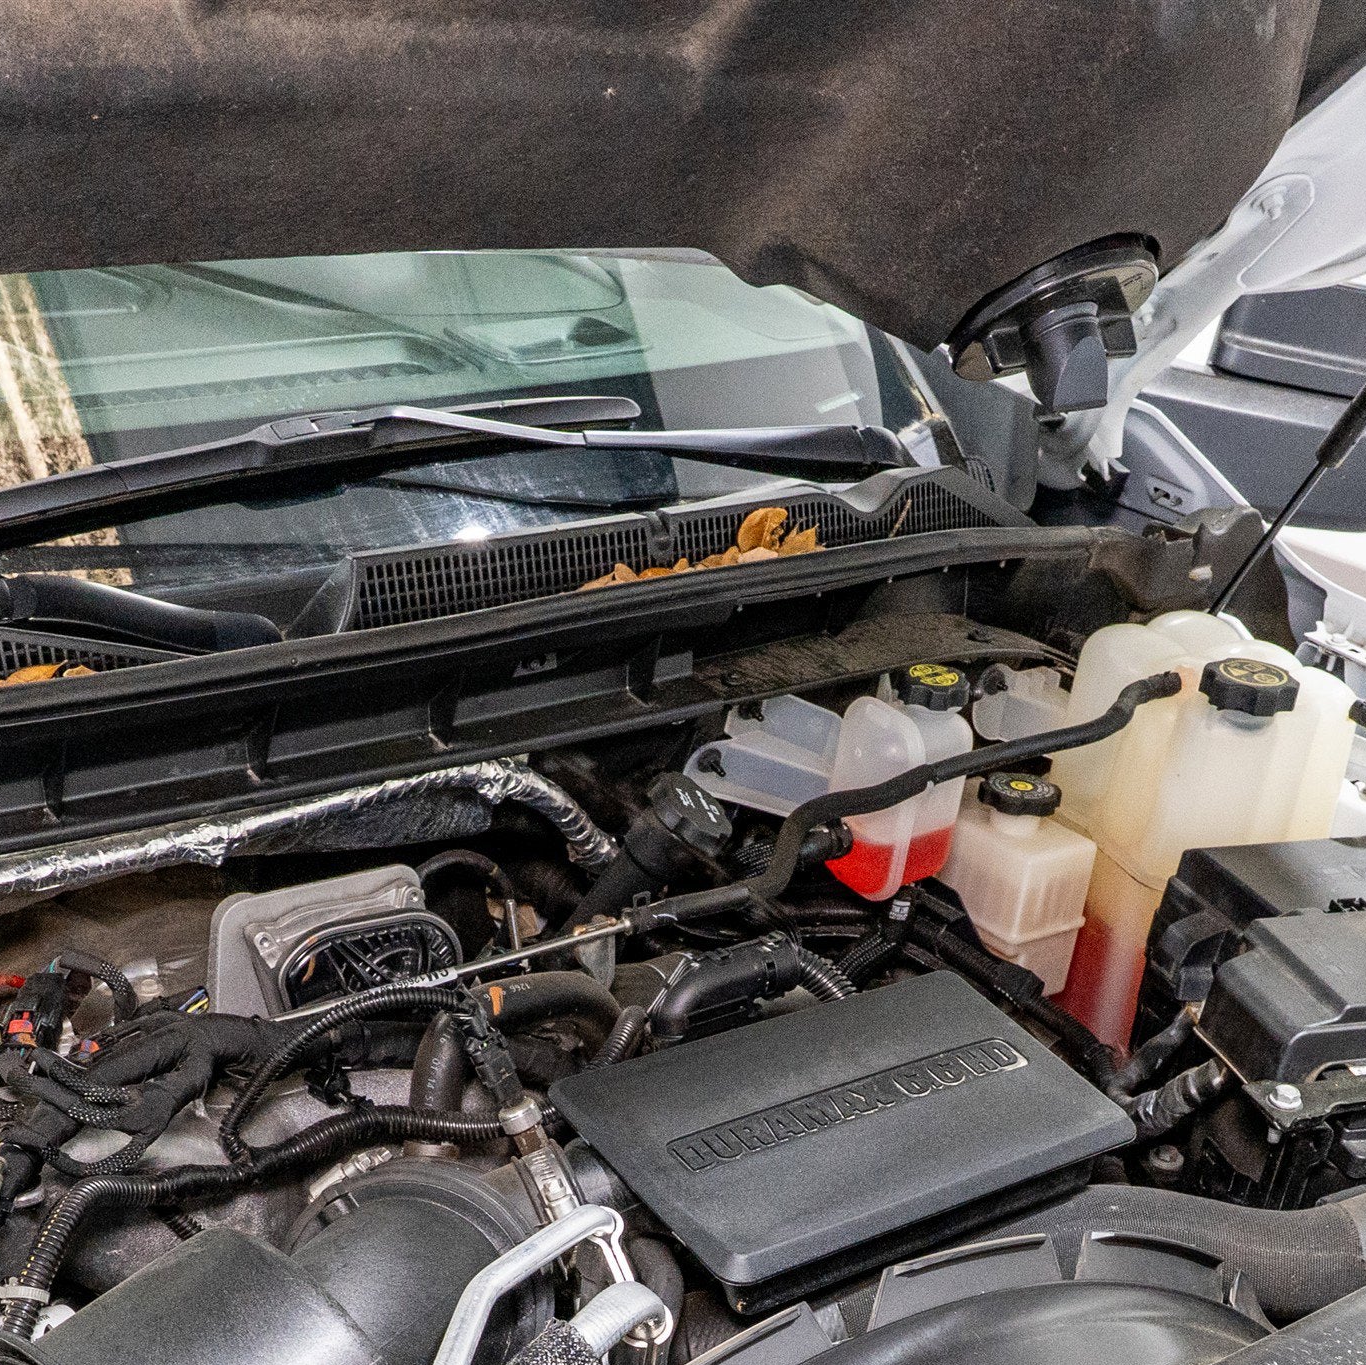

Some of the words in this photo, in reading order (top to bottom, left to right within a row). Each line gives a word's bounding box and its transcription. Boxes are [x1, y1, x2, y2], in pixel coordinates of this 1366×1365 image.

[671, 1080, 897, 1172] DURAMAX
[892, 1054, 967, 1098] 6.6
[963, 1043, 1019, 1077] HD
